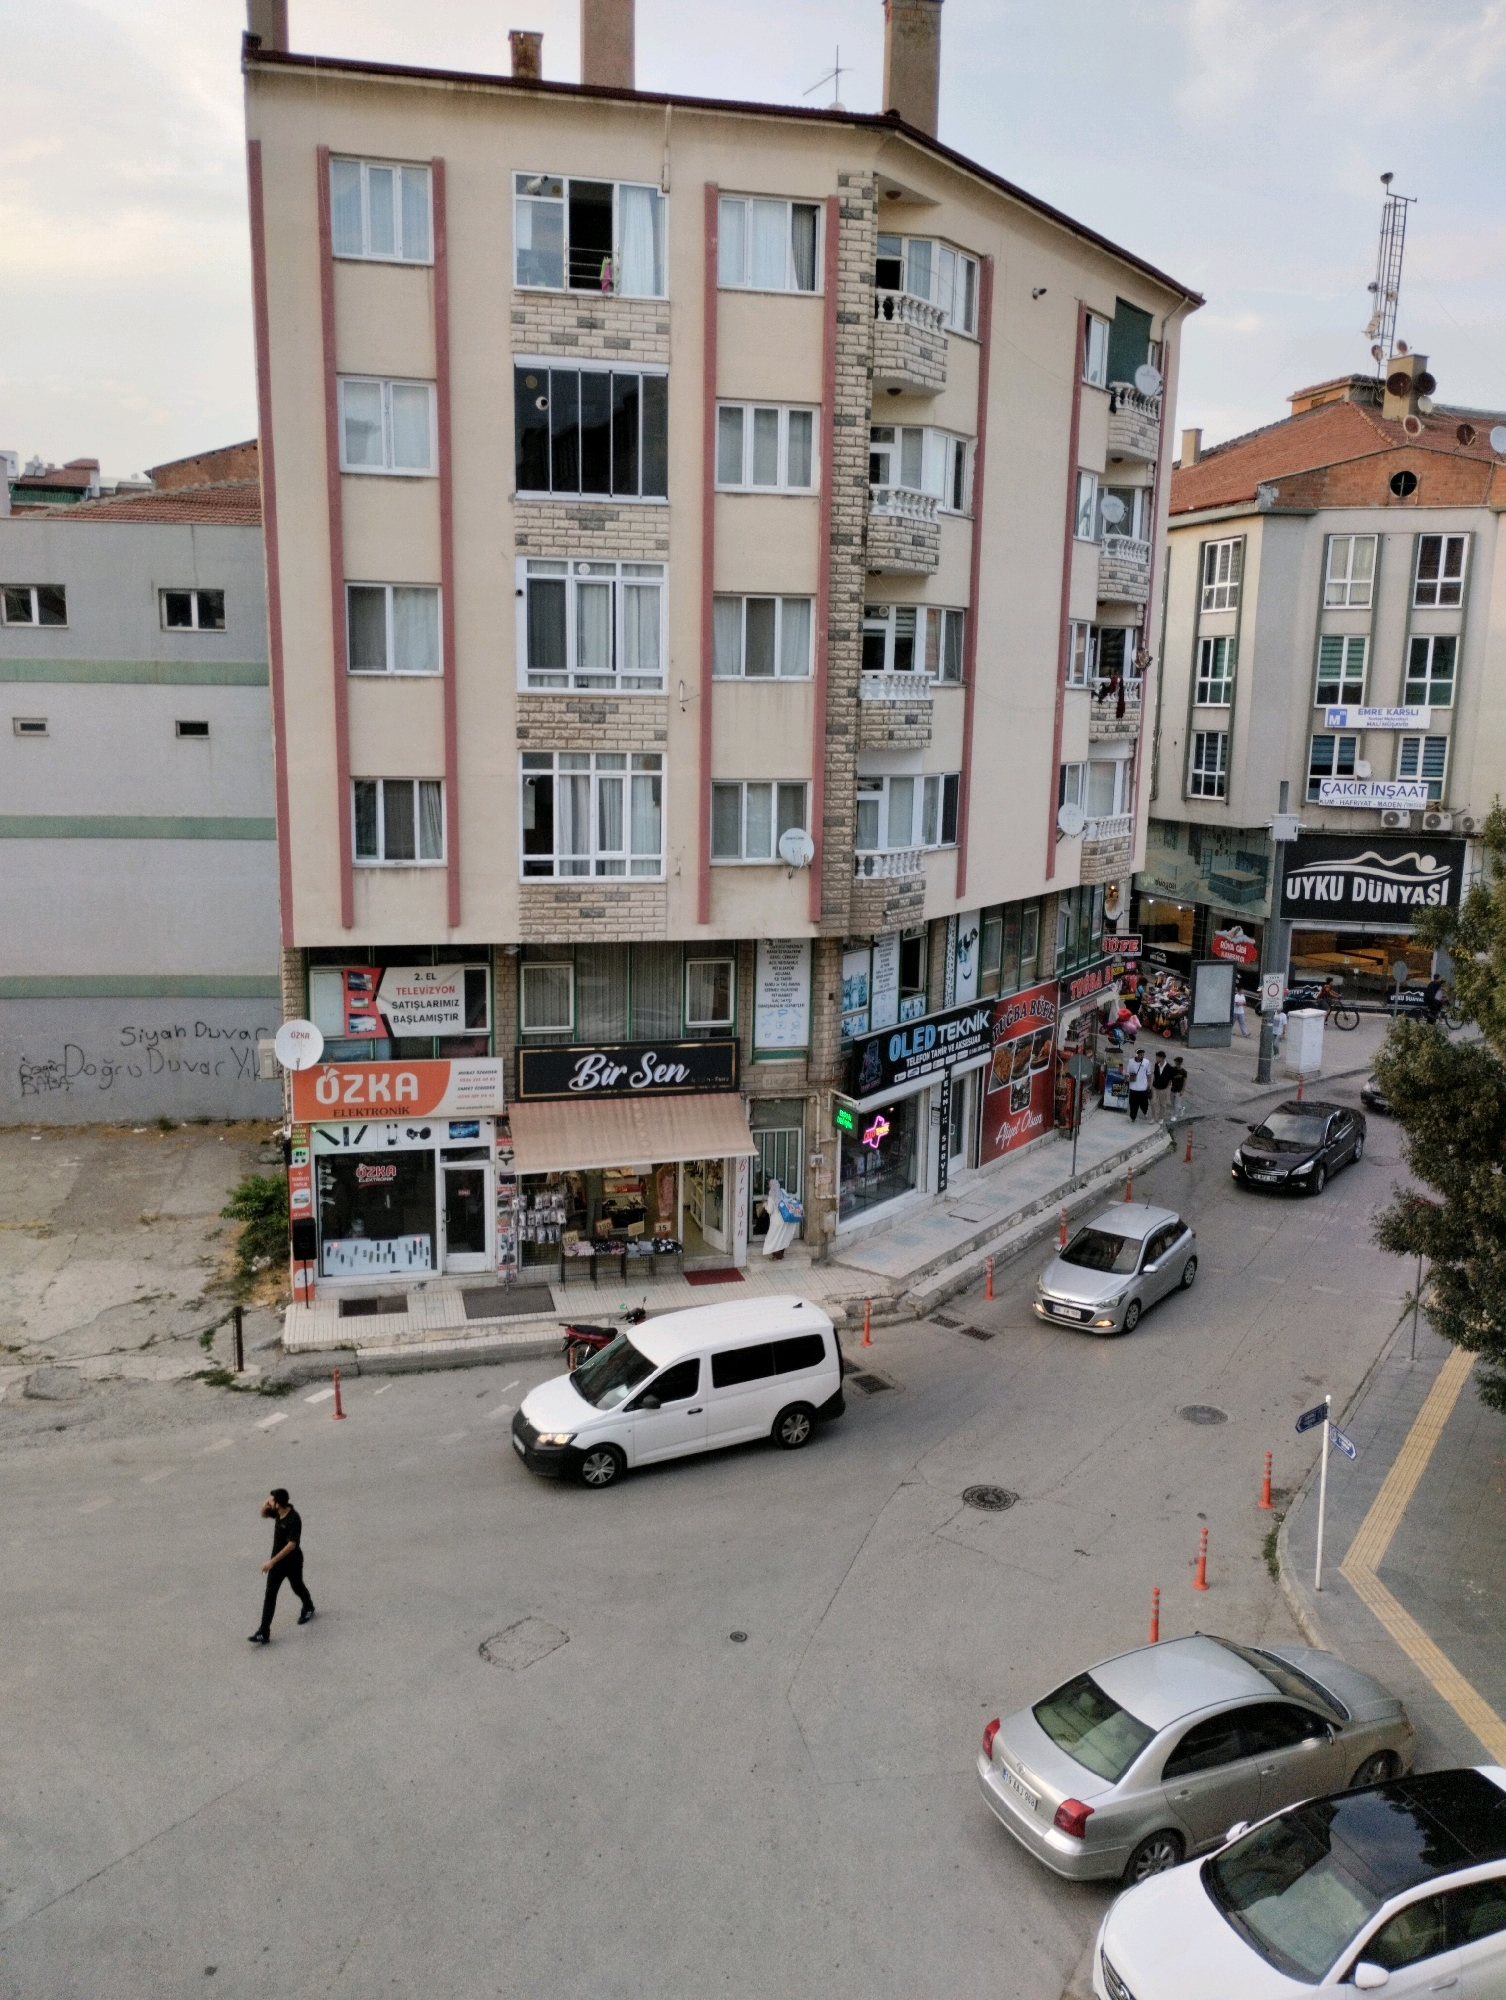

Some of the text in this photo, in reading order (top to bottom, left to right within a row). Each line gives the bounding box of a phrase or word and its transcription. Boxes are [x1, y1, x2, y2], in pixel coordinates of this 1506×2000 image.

[1358, 708, 1419, 716] EMRE KARSLI
[1322, 782, 1428, 799] ÇAKIR İNŞAAT
[1286, 876, 1450, 906] UYKU DÜNYASI
[414, 972, 436, 981] 2. EL
[1070, 970, 1102, 1001] TUĞBA
[396, 984, 456, 996] TELEVİZYON
[392, 999, 460, 1010] SATIŞLARIMIZ
[393, 1012, 459, 1025] BAŞLAMIŞTIR
[992, 995, 1055, 1044] TUĞBA BÜFE
[120, 1021, 268, 1046] Siyah Duvar
[290, 1031, 310, 1040] ÖZKA
[889, 1010, 991, 1062] OLED TEKNİK
[906, 1051, 930, 1067] TELEFON
[931, 1044, 947, 1058] TAMİR
[948, 1043, 955, 1053] VE
[955, 1034, 981, 1050] AKSESUAR
[64, 1044, 142, 1090] Doğru
[146, 1046, 225, 1076] Duvar
[568, 1051, 691, 1091] Bir Sen
[316, 1065, 419, 1105] ÖZKA
[333, 1105, 410, 1118] ELEKTRONİK
[356, 1163, 397, 1178] ÖZKA
[658, 1224, 667, 1232] 15
[1006, 1773, 1012, 1785] 19
[1013, 1781, 1023, 1795] AAJ
